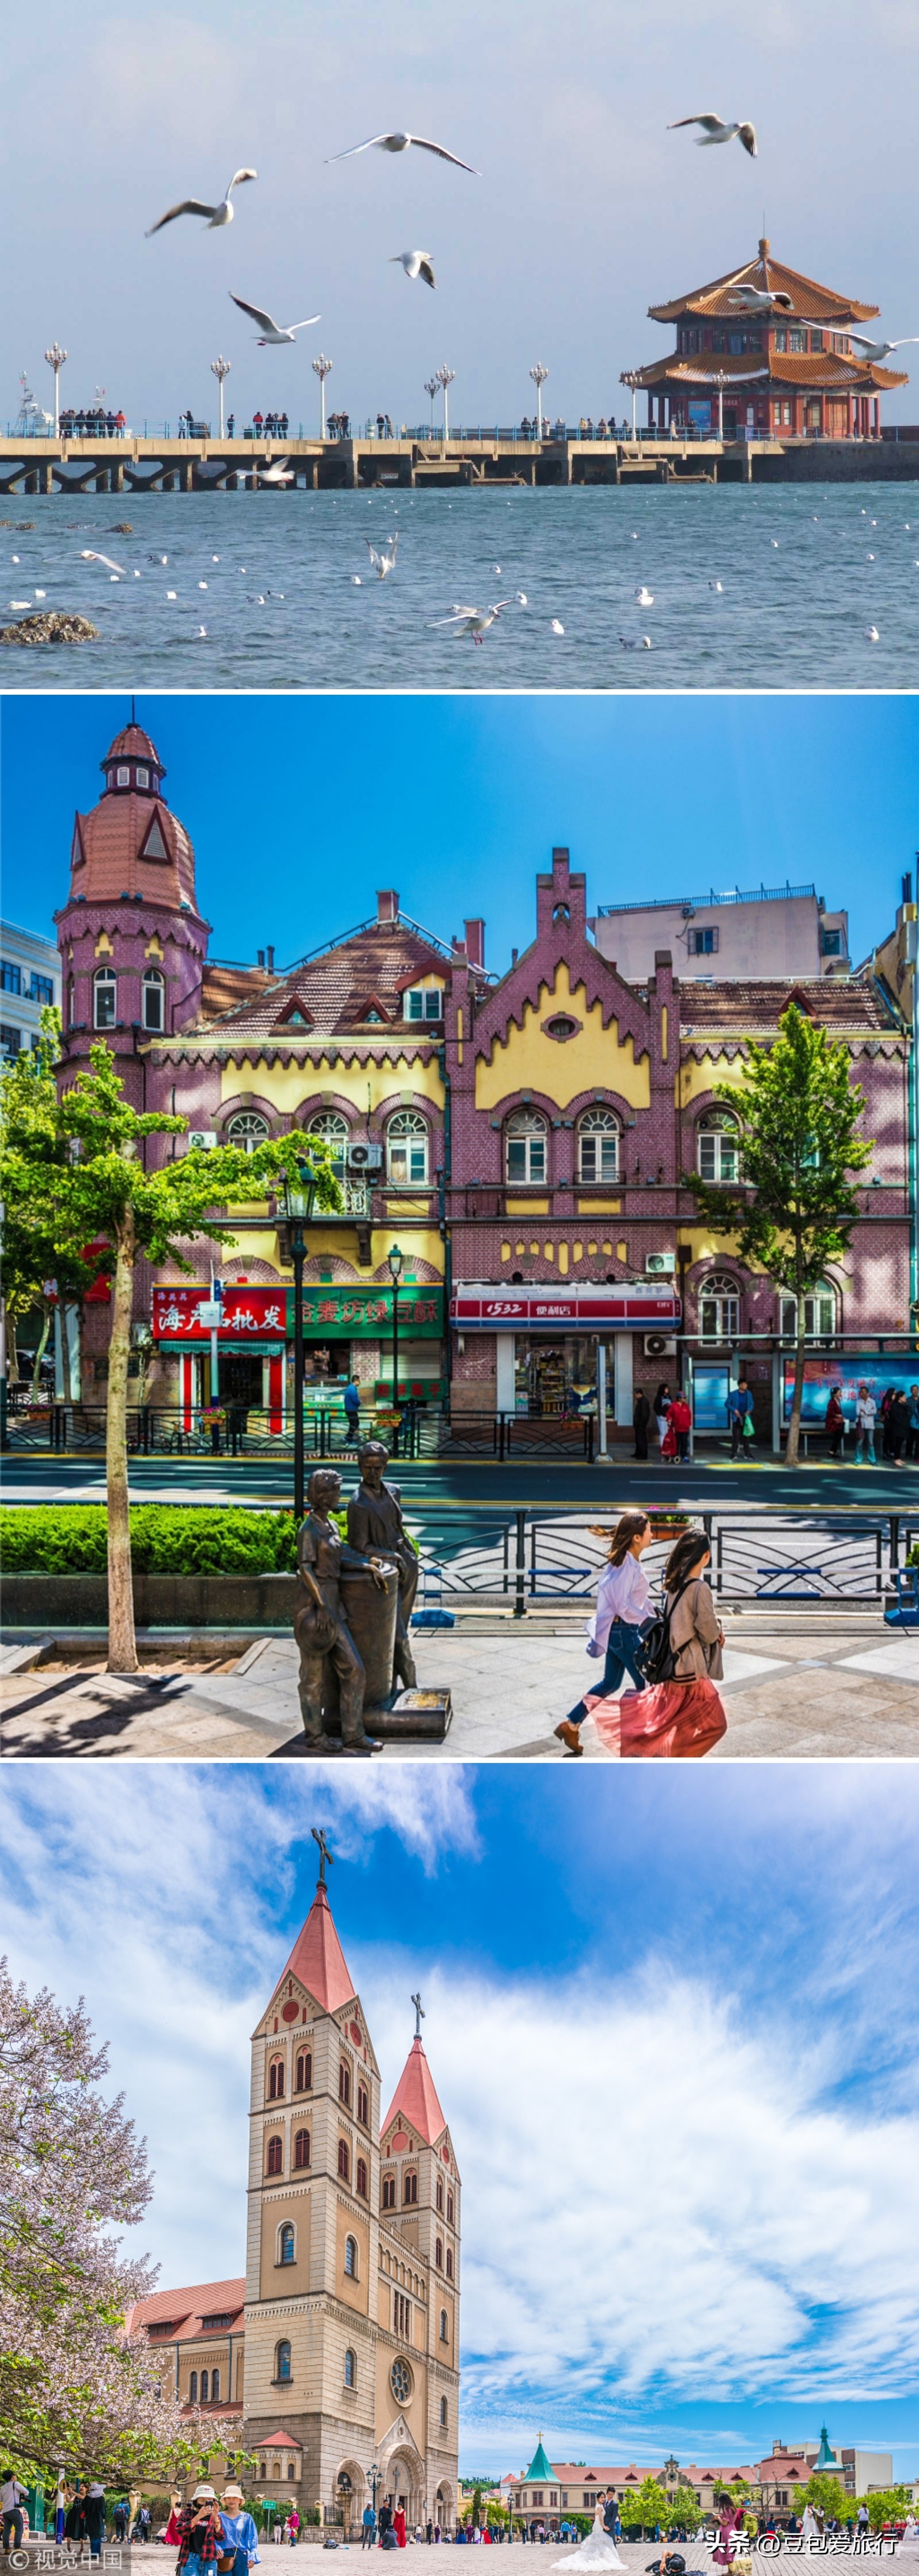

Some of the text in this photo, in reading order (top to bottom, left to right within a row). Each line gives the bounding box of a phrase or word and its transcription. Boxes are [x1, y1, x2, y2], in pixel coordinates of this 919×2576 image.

[291, 1299, 438, 1325] 金麦坊绿豆酥
[487, 1302, 522, 1316] 1532
[536, 1306, 570, 1315] 便利店
